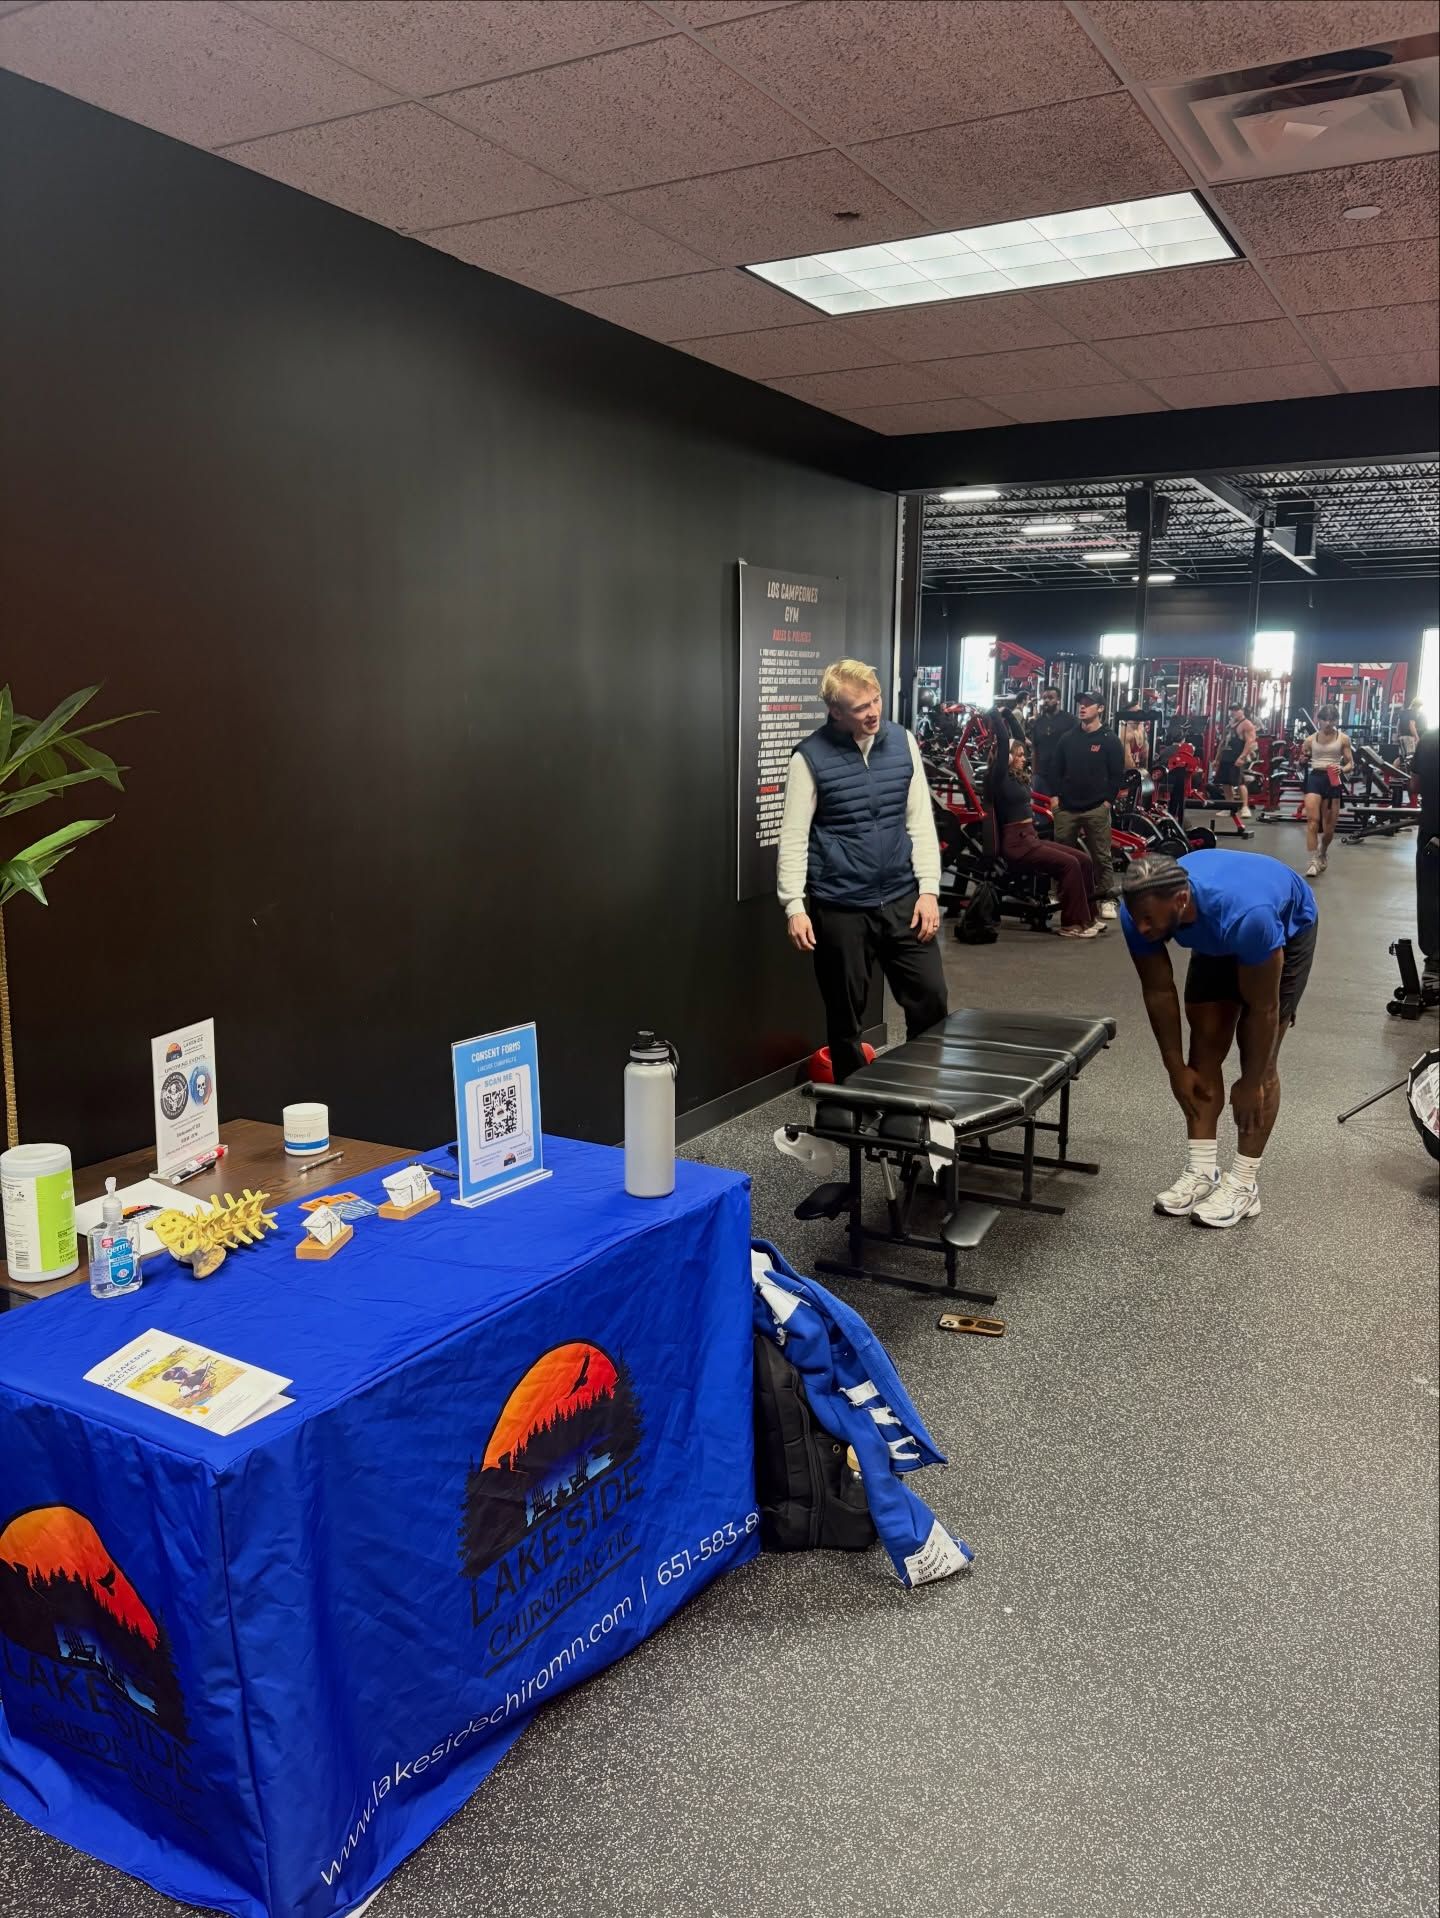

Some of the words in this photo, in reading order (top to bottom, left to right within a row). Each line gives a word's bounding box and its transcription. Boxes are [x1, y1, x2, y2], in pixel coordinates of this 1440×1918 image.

[767, 581, 780, 599] LOS
[781, 583, 818, 604] CAMPEONES
[784, 606, 800, 623] GYM
[471, 1046, 501, 1063] CONSENT
[501, 1040, 521, 1055] FORMS
[484, 1076, 502, 1088] SCAN
[503, 1072, 513, 1082] ME
[472, 1456, 645, 1629] LAKESIDE
[489, 1523, 634, 1657] CHIROPRACTIC
[320, 1595, 633, 1886] www.lakesidechiromn.com
[657, 1508, 760, 1586] 651-583-8
